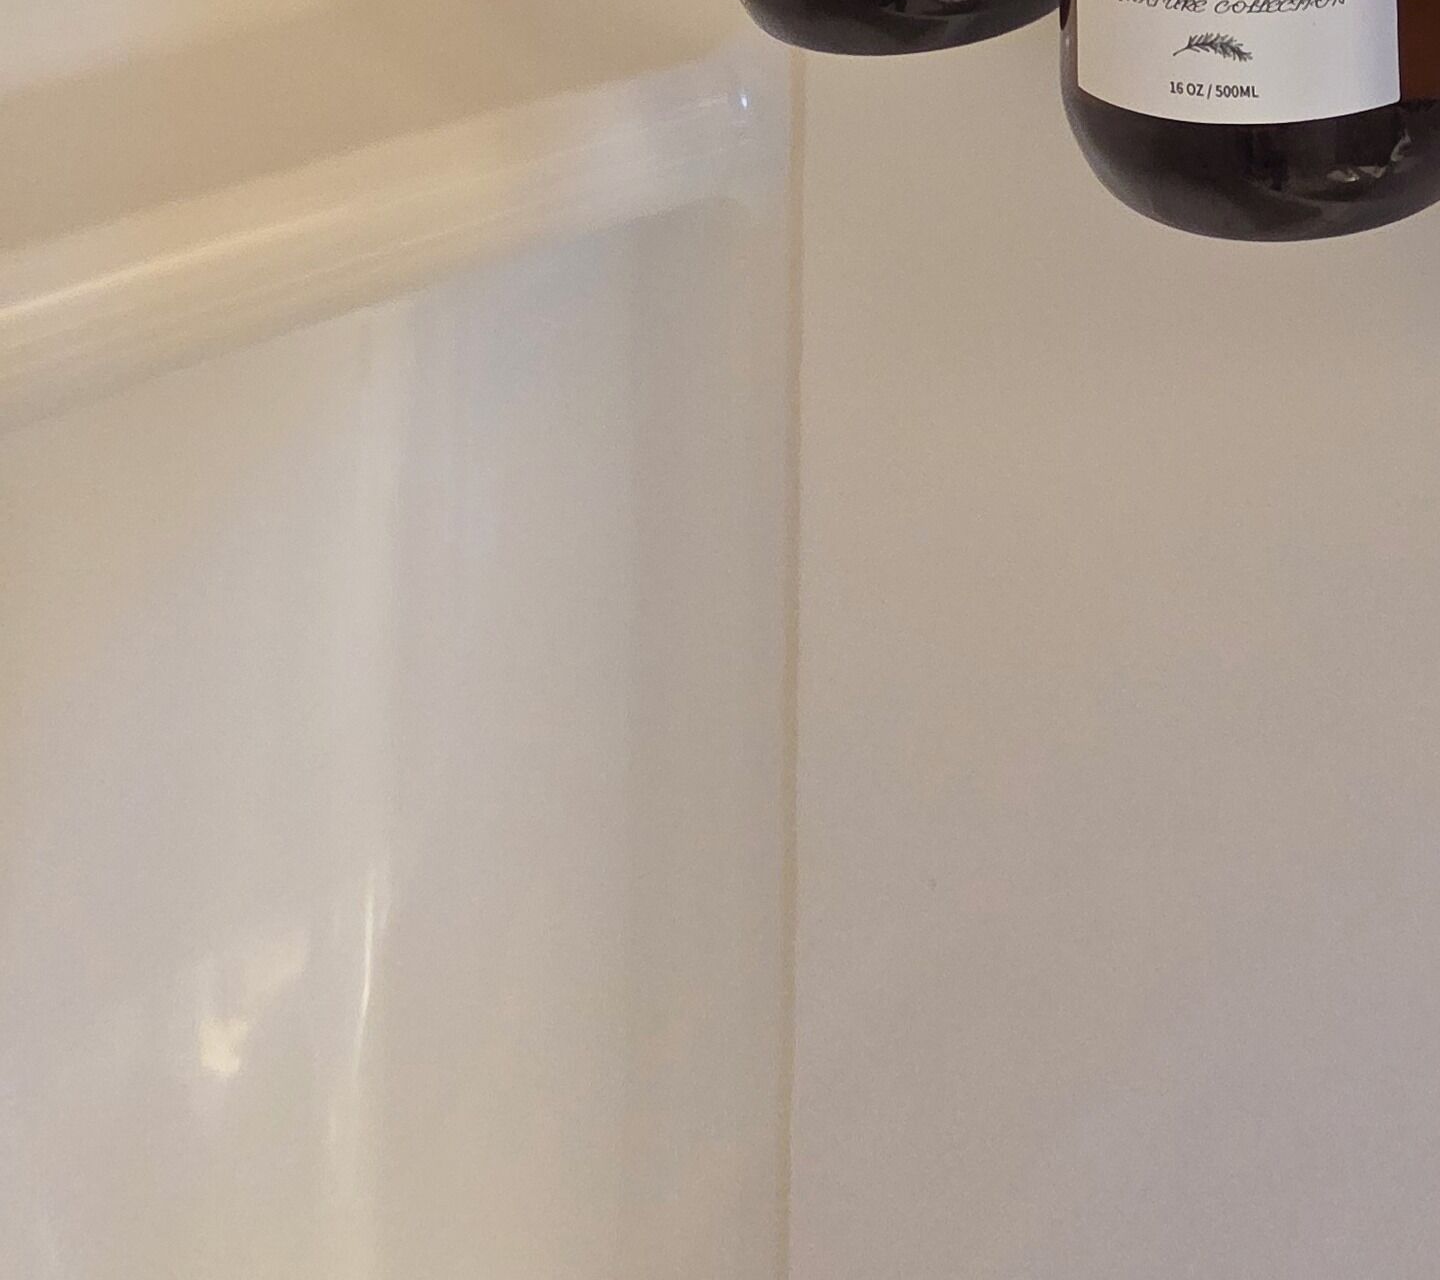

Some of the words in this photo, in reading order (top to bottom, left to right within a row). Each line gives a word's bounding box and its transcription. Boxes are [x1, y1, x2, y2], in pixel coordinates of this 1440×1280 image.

[1169, 80, 1184, 95] 16
[1185, 82, 1205, 97] OZ
[1206, 83, 1213, 100] /
[1215, 84, 1260, 99] 500ML
